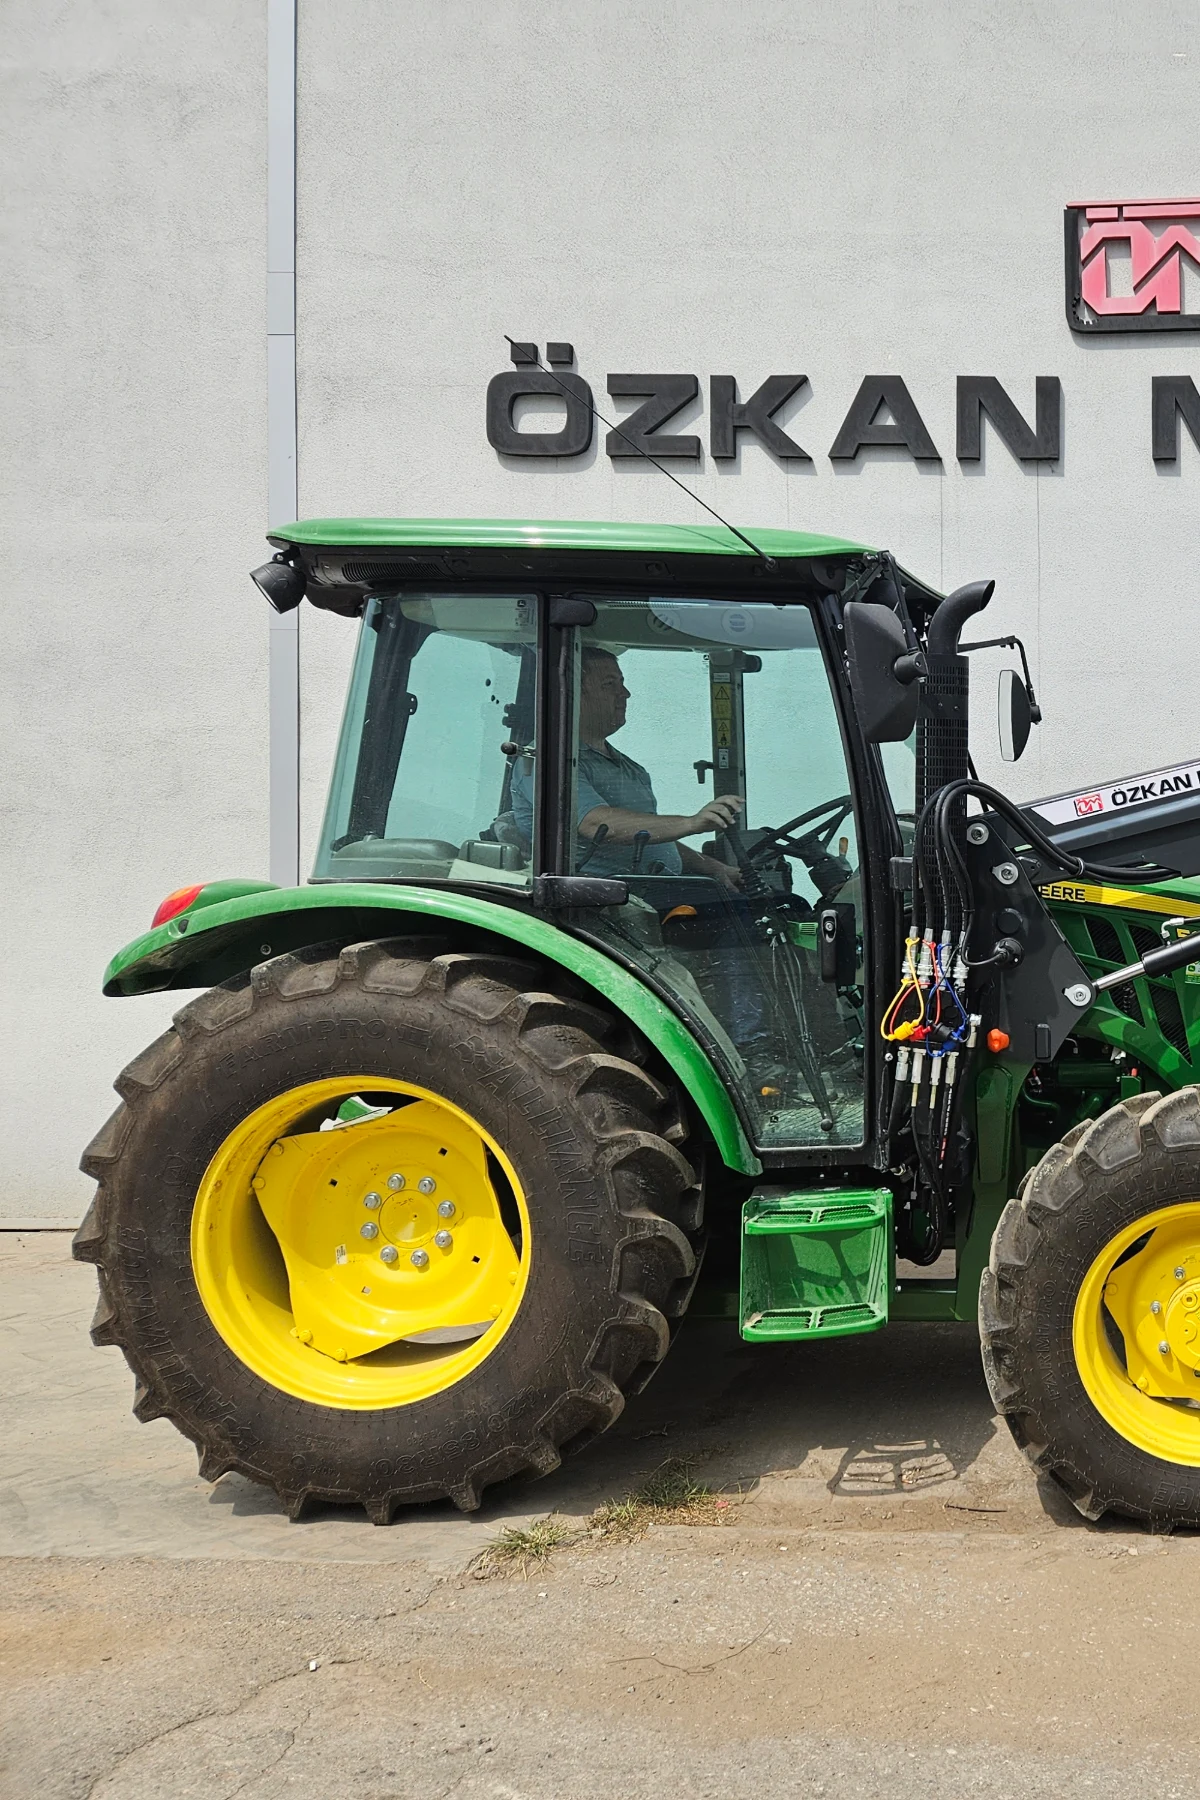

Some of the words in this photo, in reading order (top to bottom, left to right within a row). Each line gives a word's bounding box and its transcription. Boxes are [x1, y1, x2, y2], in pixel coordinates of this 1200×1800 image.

[487, 342, 1061, 461] ÖZKAN
[1111, 774, 1192, 807] ÖZKAN
[217, 1018, 387, 1078] FARMPRO
[477, 1062, 602, 1263] ALLIANCE
